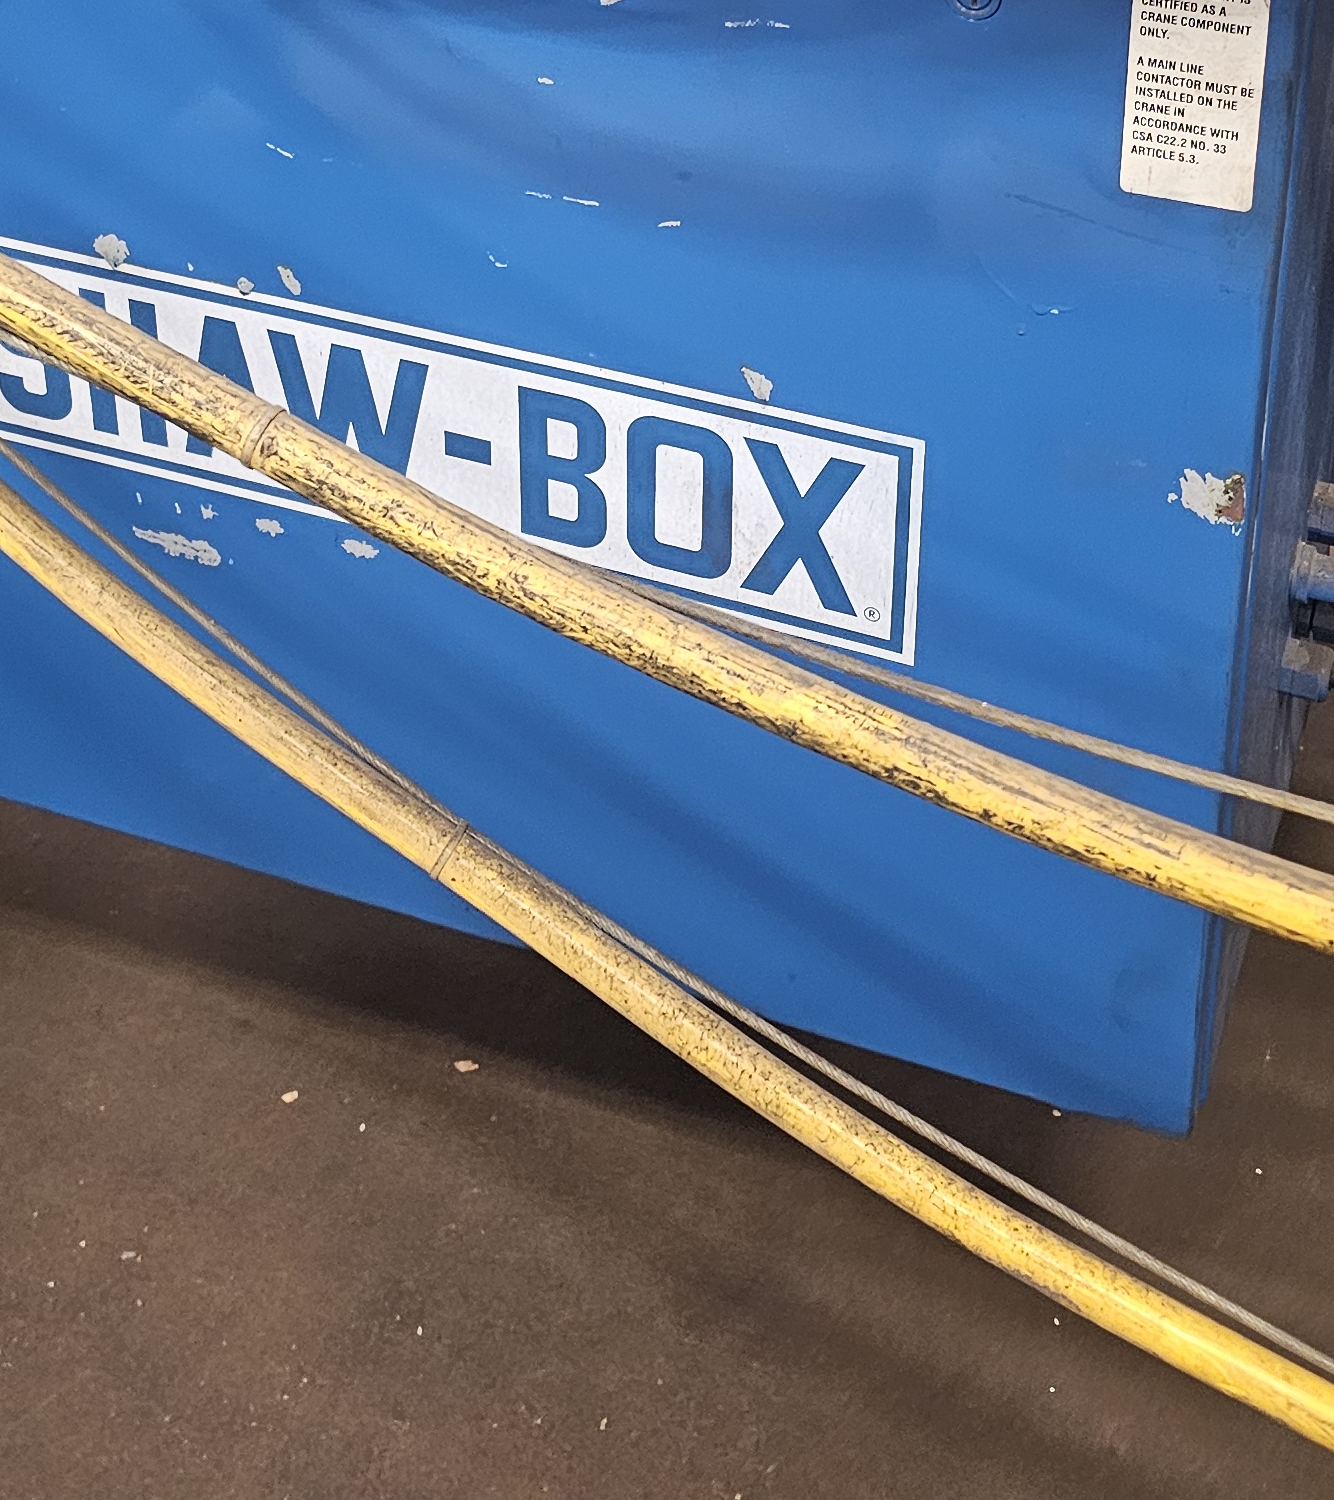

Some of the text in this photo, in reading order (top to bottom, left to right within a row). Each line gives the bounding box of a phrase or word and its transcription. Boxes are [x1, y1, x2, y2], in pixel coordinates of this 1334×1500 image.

[1201, 4, 1215, 15] AS
[1219, 6, 1227, 16] A
[1140, 26, 1170, 40] ONLY.
[1141, 11, 1251, 36] CRANE COMPONENT
[1137, 56, 1204, 75] A MAIN LINE
[1136, 71, 1254, 98] CONTACTOR MUST BE
[1134, 101, 1185, 117] CRANE IN
[1135, 86, 1237, 111] INSTALLED ON THE
[1133, 116, 1239, 141] ACCORDANCE WITH
[1132, 130, 1227, 154] CSA C22.2 NO. 33
[1131, 145, 1199, 165] ARTICLE 5.3.
